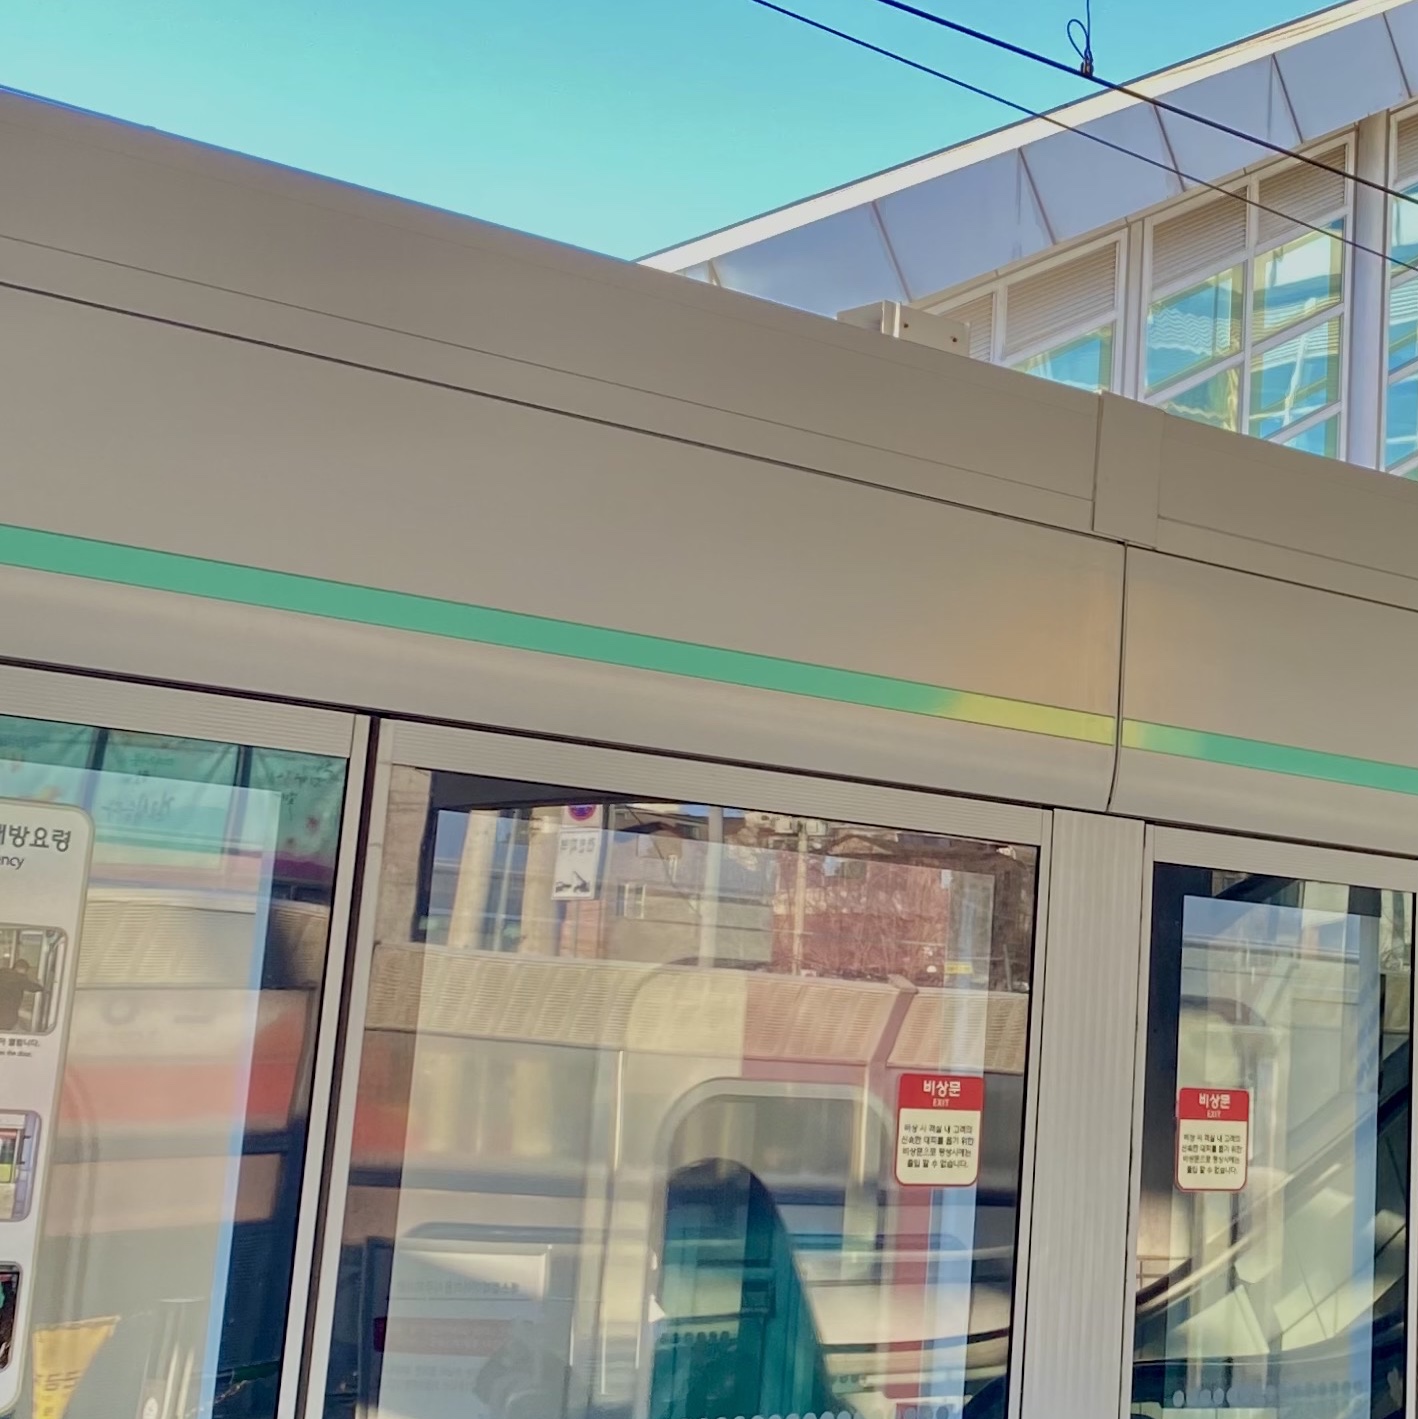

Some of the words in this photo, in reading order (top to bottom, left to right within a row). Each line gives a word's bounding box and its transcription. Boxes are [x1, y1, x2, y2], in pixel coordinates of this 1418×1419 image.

[0, 855, 26, 871] ncy
[922, 1079, 961, 1097] 비상문
[932, 1097, 950, 1107] EXIT
[1198, 1092, 1231, 1110] 비상문
[1206, 1109, 1222, 1119] EXIT
